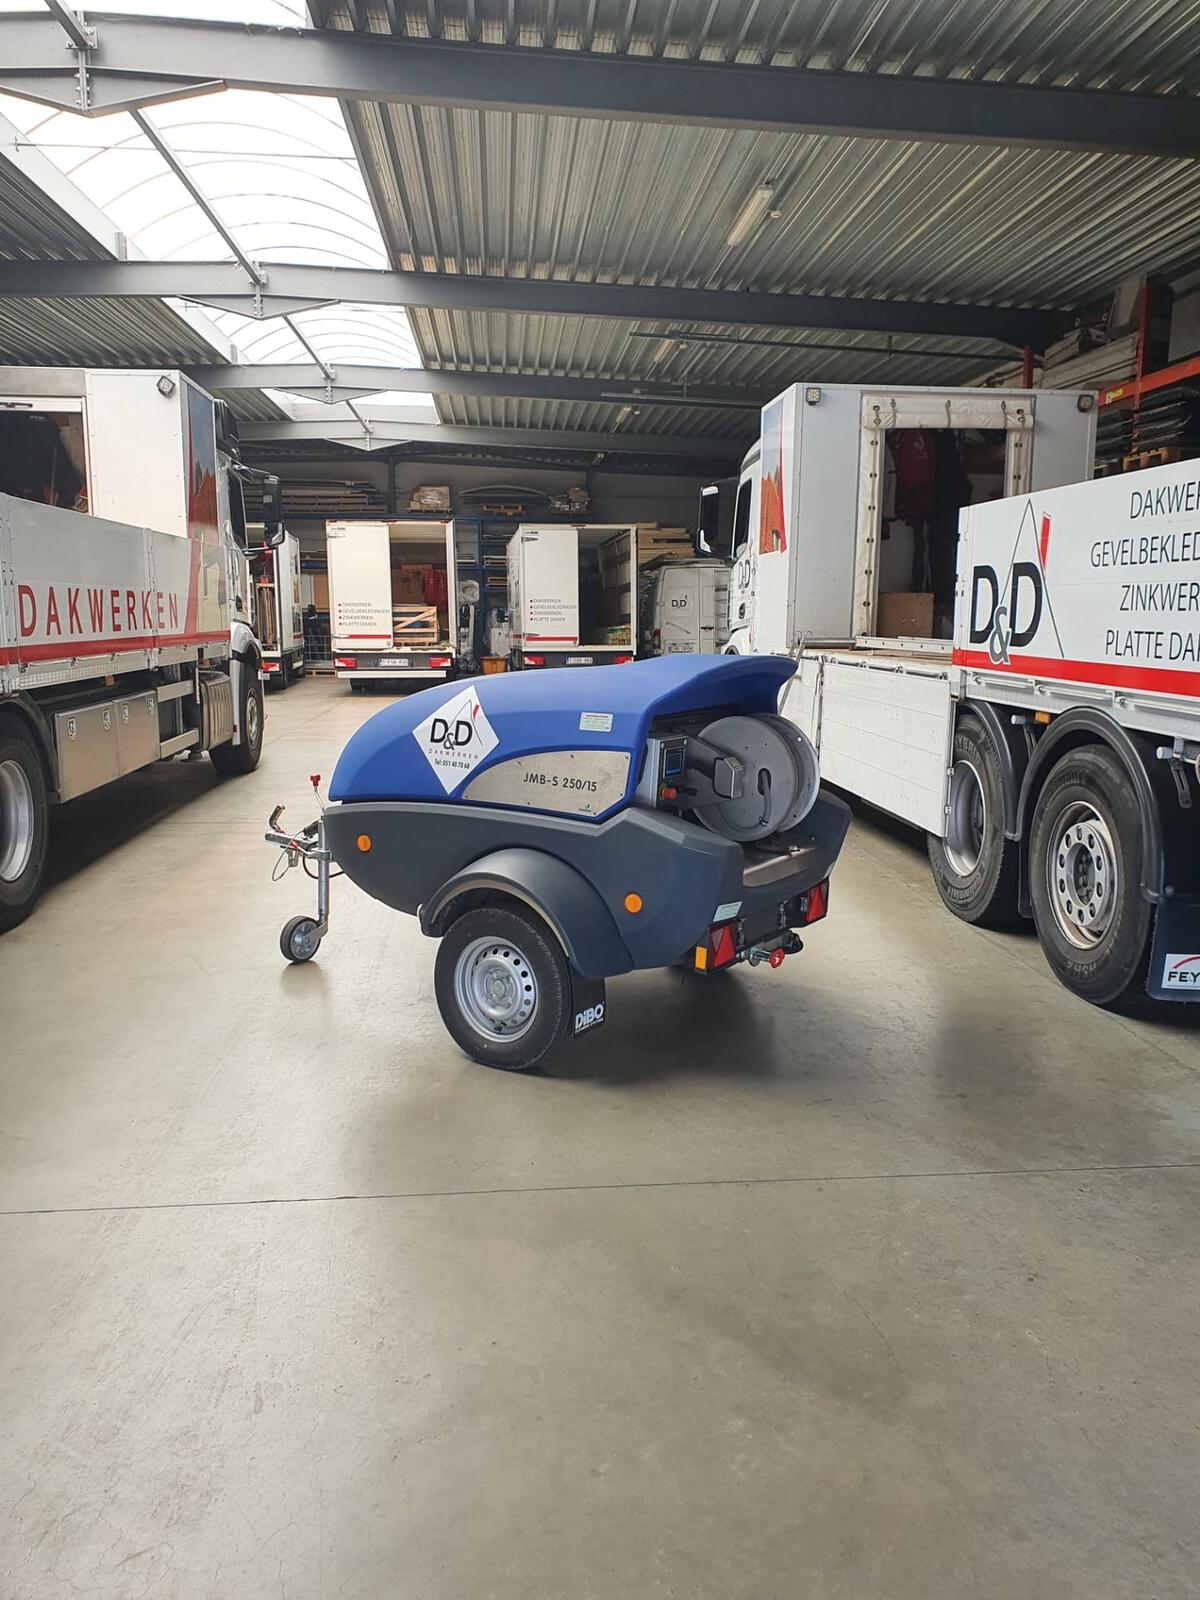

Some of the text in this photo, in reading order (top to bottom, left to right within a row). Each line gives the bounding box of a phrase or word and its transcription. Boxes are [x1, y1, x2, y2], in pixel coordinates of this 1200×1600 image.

[1090, 531, 1200, 567] GEVELBEKLED
[18, 584, 179, 637] DAKWERKEN
[1119, 582, 1200, 612] ZINKWER
[969, 562, 1043, 664] D&D
[1105, 630, 1200, 662] PLATTE DA
[430, 718, 473, 750] D&D
[428, 748, 479, 759] DAKWERKEN
[442, 759, 451, 767] 051
[457, 761, 464, 769] 70
[463, 762, 470, 770] 68
[523, 772, 598, 792] JMB-S 250/15
[1167, 971, 1200, 983] FEY
